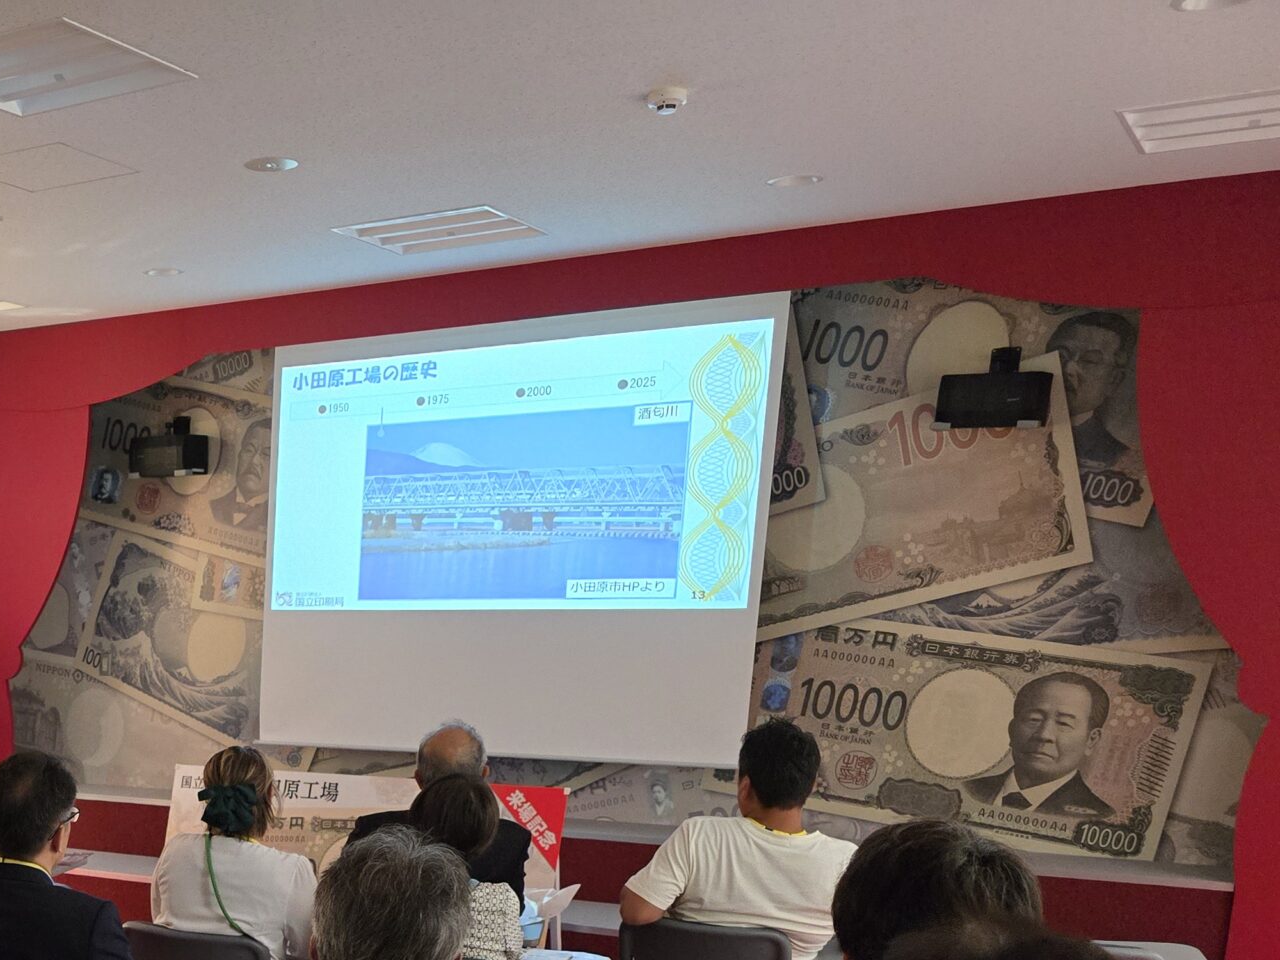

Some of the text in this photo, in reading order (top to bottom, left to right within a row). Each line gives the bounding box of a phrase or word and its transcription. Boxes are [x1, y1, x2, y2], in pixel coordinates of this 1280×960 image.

[826, 288, 910, 311] AA000000AA
[803, 319, 889, 371] 1000
[216, 352, 251, 379] 10000
[292, 360, 438, 391] 小田原工場の歴史
[629, 376, 657, 388] 2025
[427, 393, 449, 405] 1975
[526, 385, 552, 397] 2000
[328, 402, 350, 413] 1950
[638, 404, 679, 420] 酒匂川
[886, 403, 1013, 466] 10
[1084, 474, 1134, 504] 1000
[570, 581, 665, 593] 小田原市HPより
[691, 591, 706, 600] 13
[295, 596, 344, 607] 国立印刷局
[813, 648, 895, 668] AA000000AA
[924, 641, 1020, 666] 日本銀行券
[35, 662, 70, 678] NIPPON
[801, 677, 907, 731] 10000
[819, 730, 839, 741] BANK
[849, 734, 873, 746] JAPAN
[821, 722, 875, 736] 日本銀行
[181, 776, 204, 789] 国立
[505, 788, 559, 851] 来場記念
[977, 807, 1067, 833] AA000000AA
[1080, 823, 1137, 852] 10000
